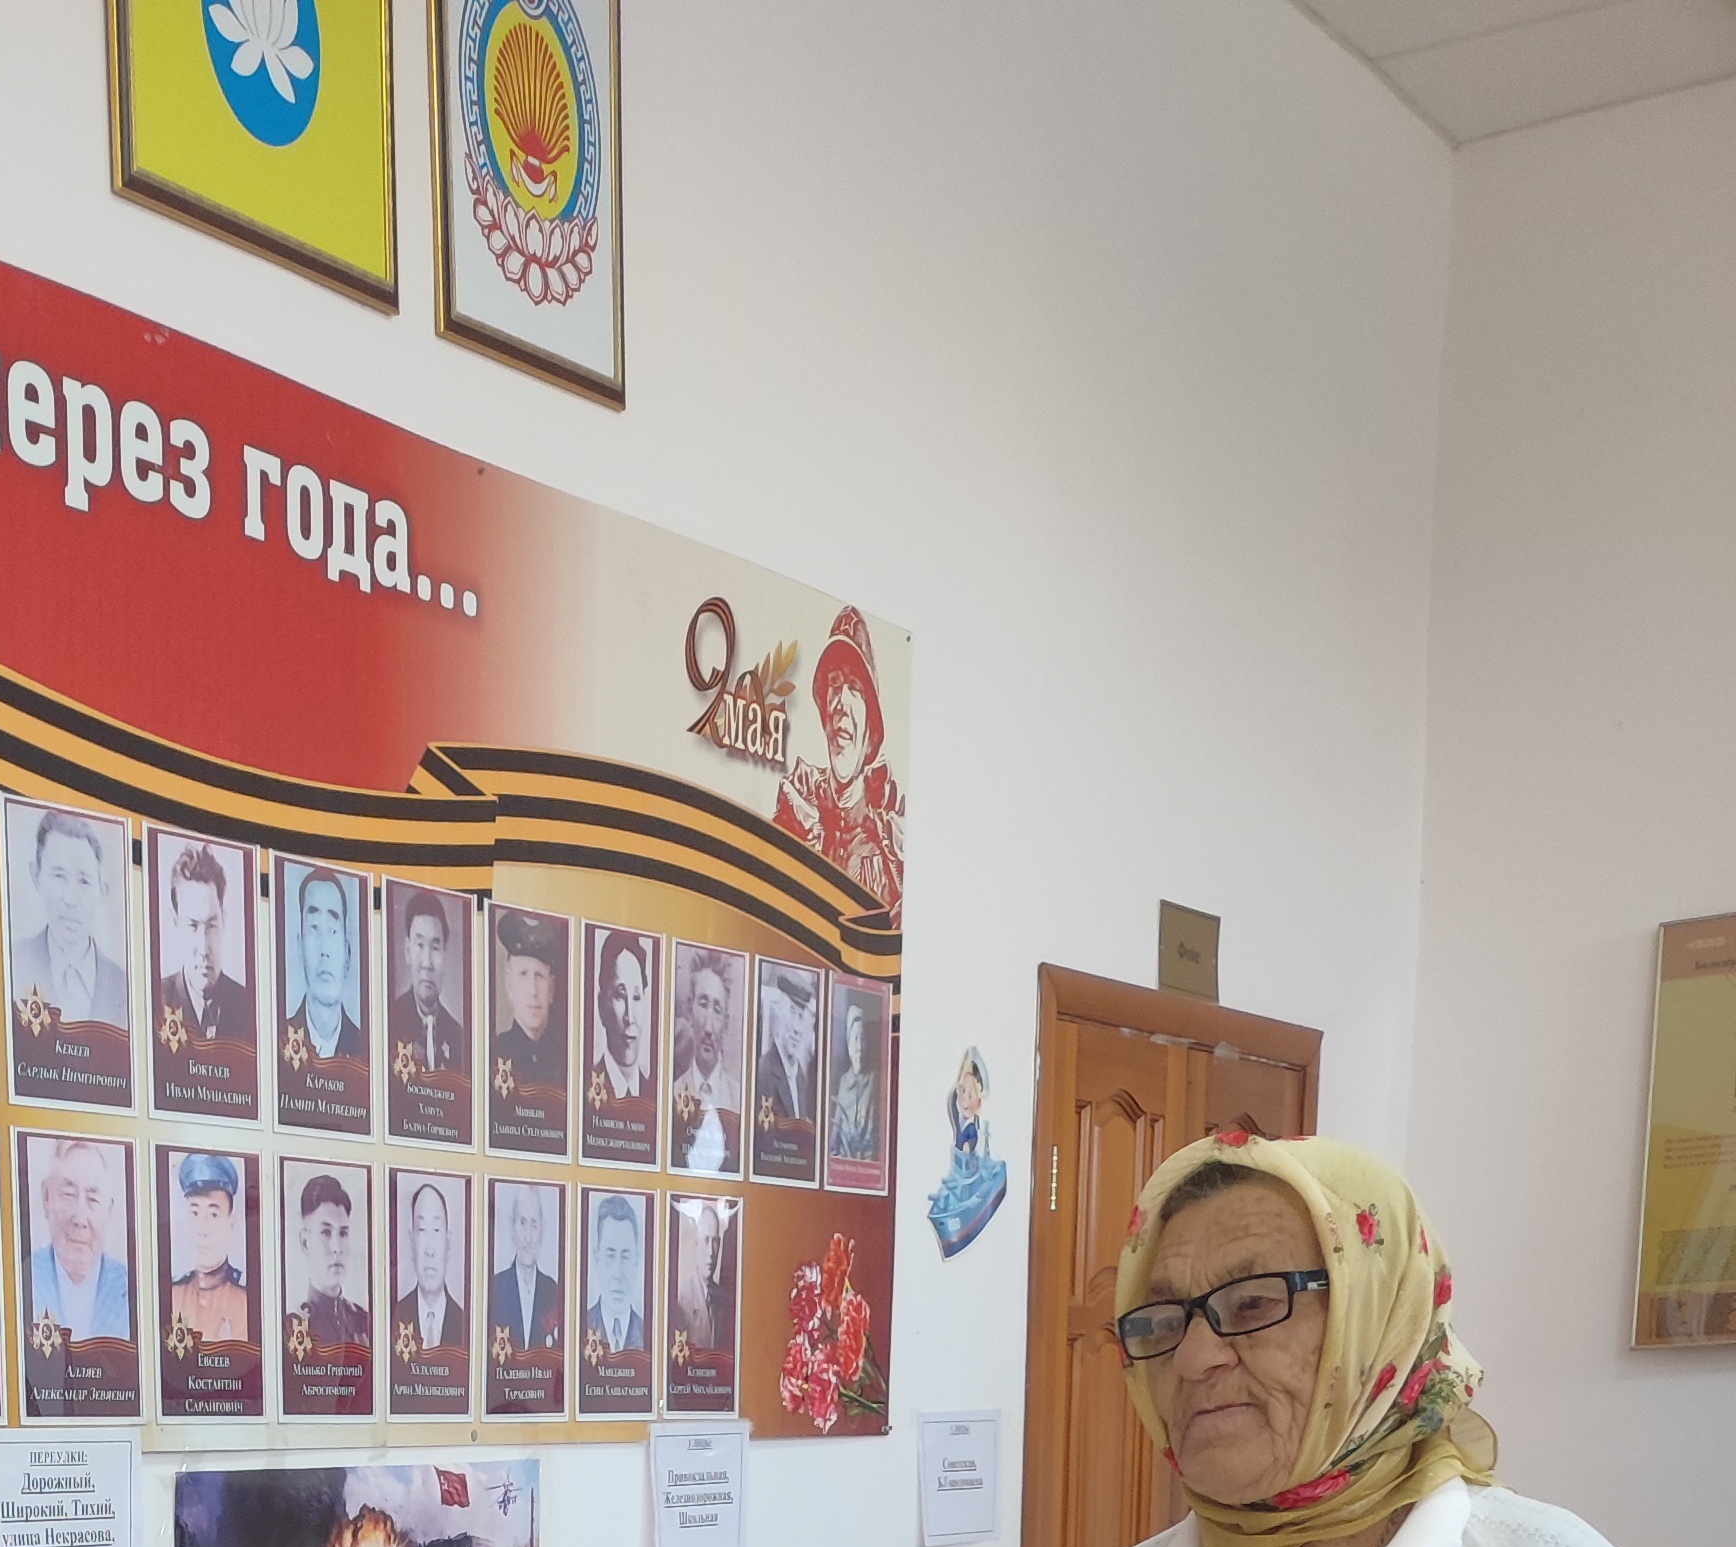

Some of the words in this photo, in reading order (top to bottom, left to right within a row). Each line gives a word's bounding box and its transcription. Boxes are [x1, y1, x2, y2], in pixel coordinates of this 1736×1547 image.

[244, 444, 479, 619] года...
[21, 1472, 95, 1492] Дорожный,
[0, 1500, 68, 1520] Широкий,
[71, 1498, 116, 1518] Тихий,
[2, 1532, 41, 1547] улица
[45, 1527, 115, 1547] Некрасова,
